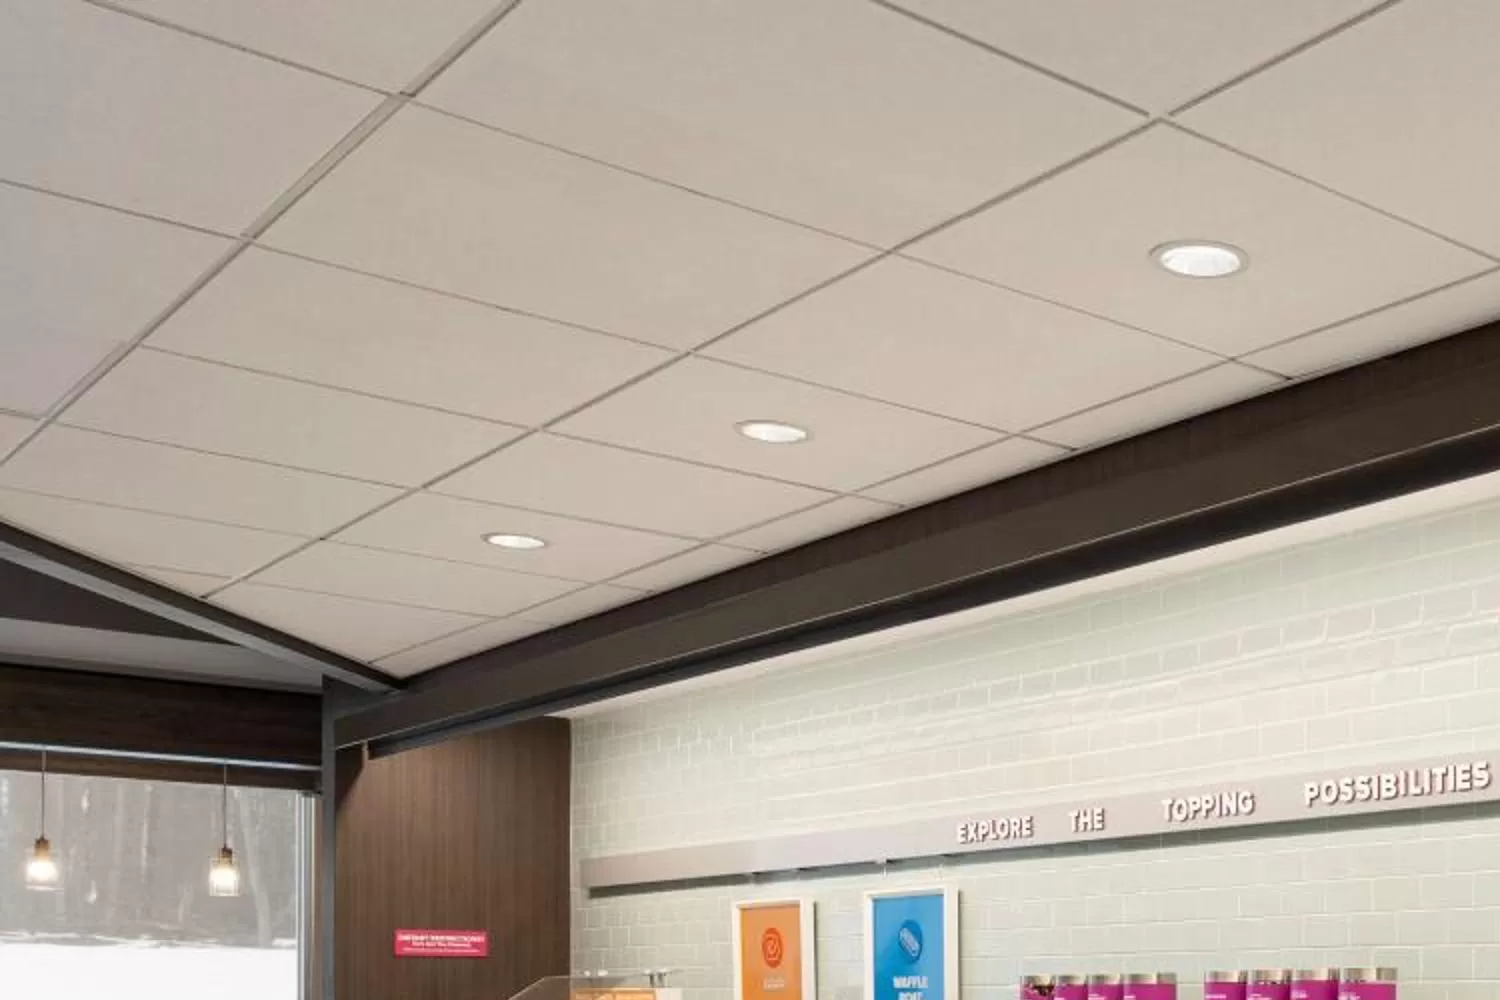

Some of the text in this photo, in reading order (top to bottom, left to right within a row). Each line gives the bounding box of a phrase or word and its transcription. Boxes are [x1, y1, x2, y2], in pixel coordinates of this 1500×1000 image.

[956, 761, 1492, 844] EXPLORE THE TOPPING POSSIBILITIES
